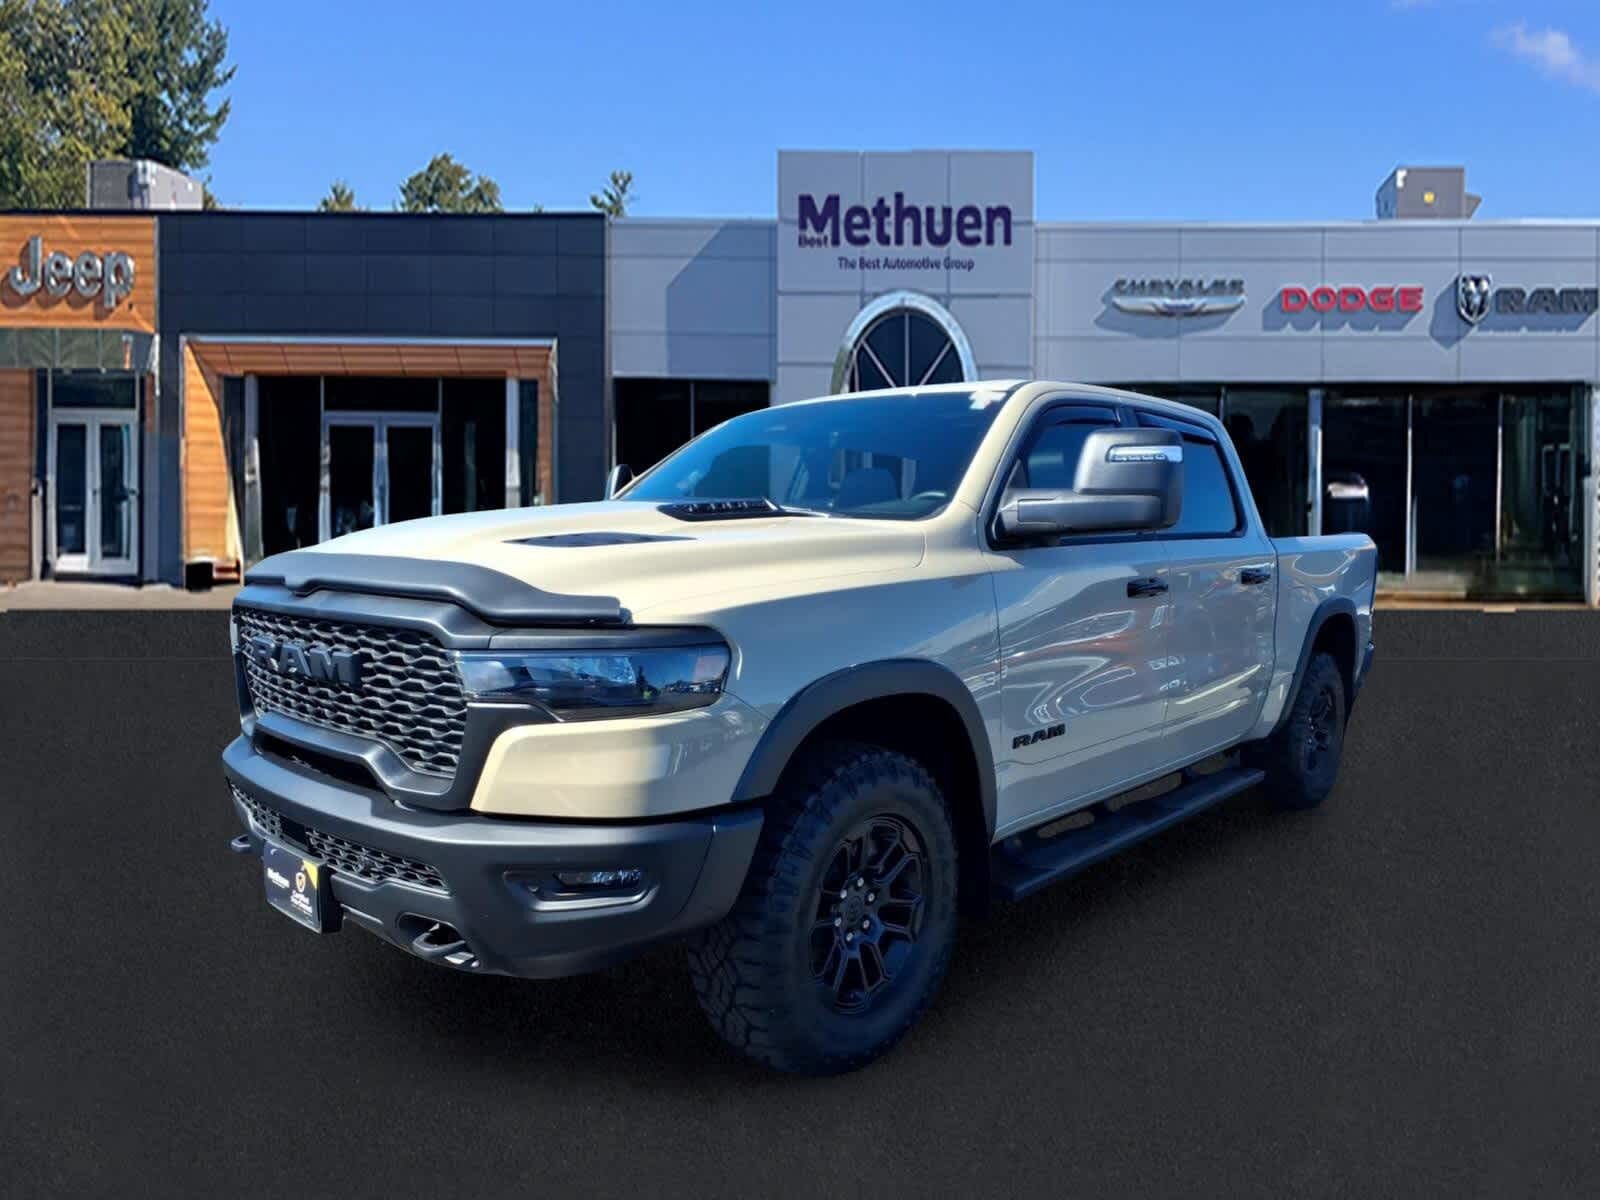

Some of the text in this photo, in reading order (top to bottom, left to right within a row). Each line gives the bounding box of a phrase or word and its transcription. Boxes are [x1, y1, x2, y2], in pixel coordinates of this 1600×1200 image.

[798, 191, 1013, 247] Methuen
[798, 234, 829, 248] Best
[9, 235, 136, 309] Jeep
[837, 256, 975, 272] The Best Automotive Group
[1282, 286, 1424, 312] DODGE
[1495, 287, 1599, 314] RAM
[250, 635, 360, 686] RAM
[1011, 723, 1066, 750] RAM
